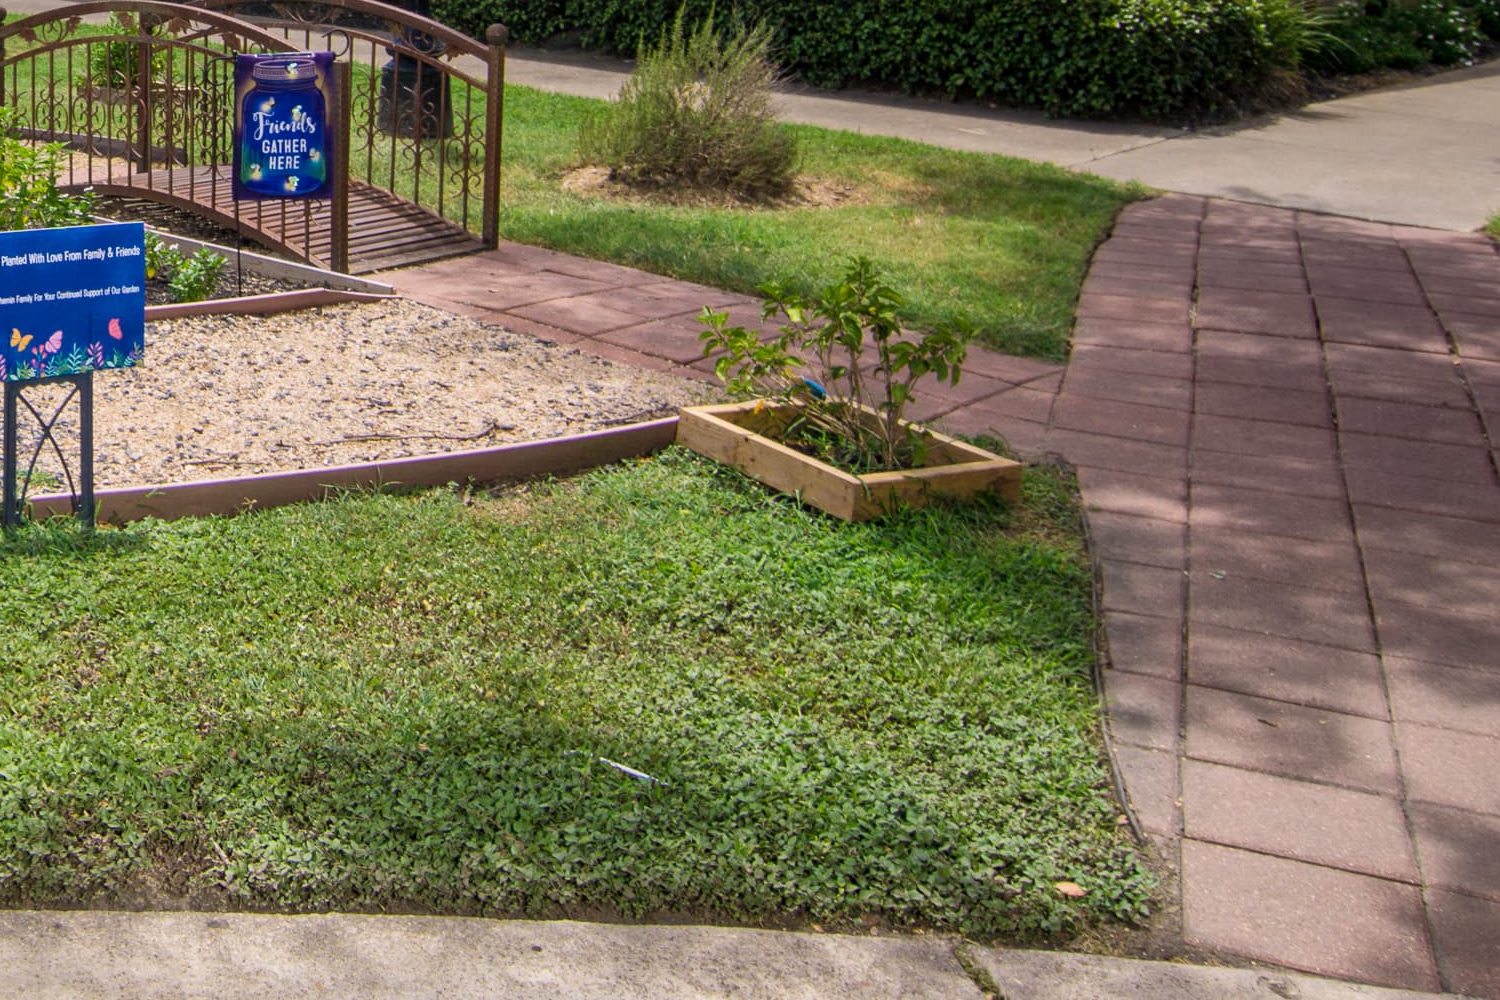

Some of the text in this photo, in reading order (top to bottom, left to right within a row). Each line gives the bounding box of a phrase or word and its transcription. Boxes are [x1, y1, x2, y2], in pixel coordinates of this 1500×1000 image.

[252, 111, 316, 140] Friends
[262, 139, 307, 153] GATHER
[269, 156, 300, 170] HERE
[1, 254, 27, 266] Planted
[29, 253, 45, 264] With
[46, 252, 63, 263] Love
[64, 250, 82, 262] From
[83, 248, 106, 261] Family
[107, 246, 114, 258] &
[115, 245, 141, 257] Friends
[16, 294, 33, 304] Family
[33, 293, 43, 302] For
[44, 293, 56, 301] Your
[56, 290, 83, 300] Continued
[83, 289, 104, 299] Support
[104, 287, 111, 296] of
[111, 286, 121, 295] Our
[121, 285, 140, 295] Garden
